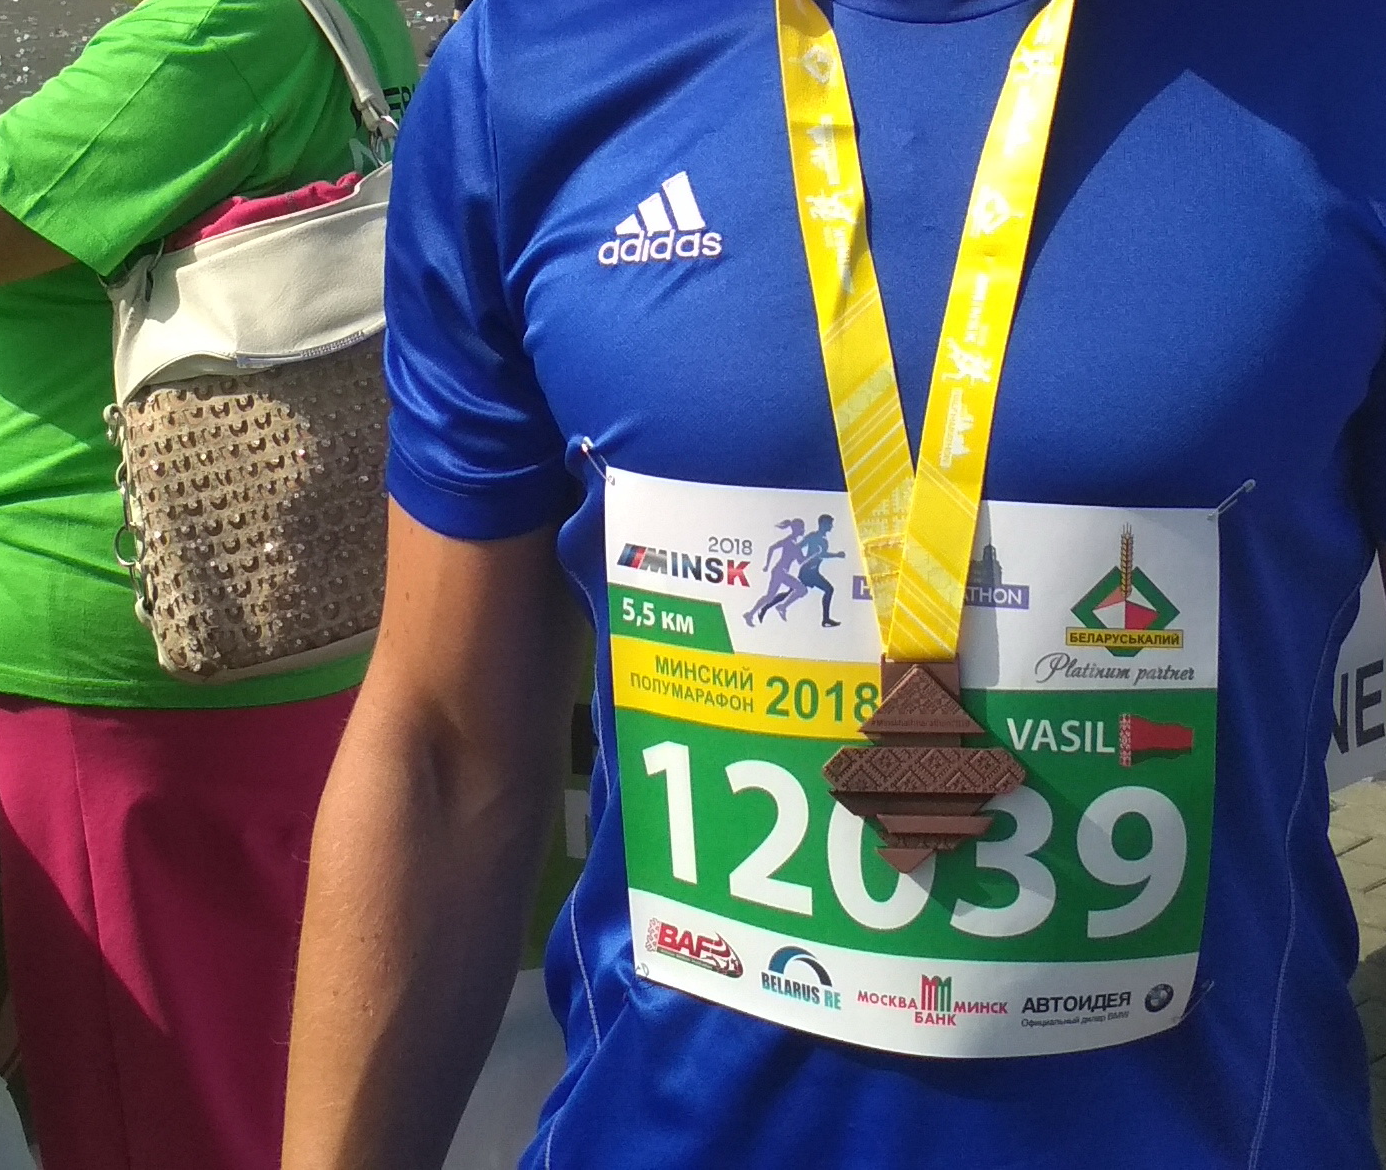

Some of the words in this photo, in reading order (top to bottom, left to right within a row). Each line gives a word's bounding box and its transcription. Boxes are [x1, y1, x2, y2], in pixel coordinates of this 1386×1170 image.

[598, 229, 723, 265] adidas
[708, 536, 753, 556] 2018
[637, 547, 751, 588] MINSK
[622, 597, 656, 627] 5,5
[964, 585, 1023, 606] THON
[1069, 631, 1180, 646] БЕЛАРУСЬКАЛИЙ
[656, 654, 754, 692] МИНСКИЙ
[1035, 652, 1130, 684] Platinum
[1135, 666, 1195, 686] partner
[630, 672, 754, 713] ПОЛУМАРАФОН
[766, 675, 879, 723] 2018
[1006, 716, 1115, 753] VASIL
[642, 740, 1188, 939] 12039
[658, 922, 727, 958] BAF
[761, 971, 820, 1004] BELARUS
[824, 989, 842, 1011] RE
[857, 990, 918, 1010] МОСКВА
[953, 1001, 1009, 1014] МИНСК
[1021, 991, 1131, 1014] АВТОИДЕЯ
[914, 1011, 957, 1026] БАНК
